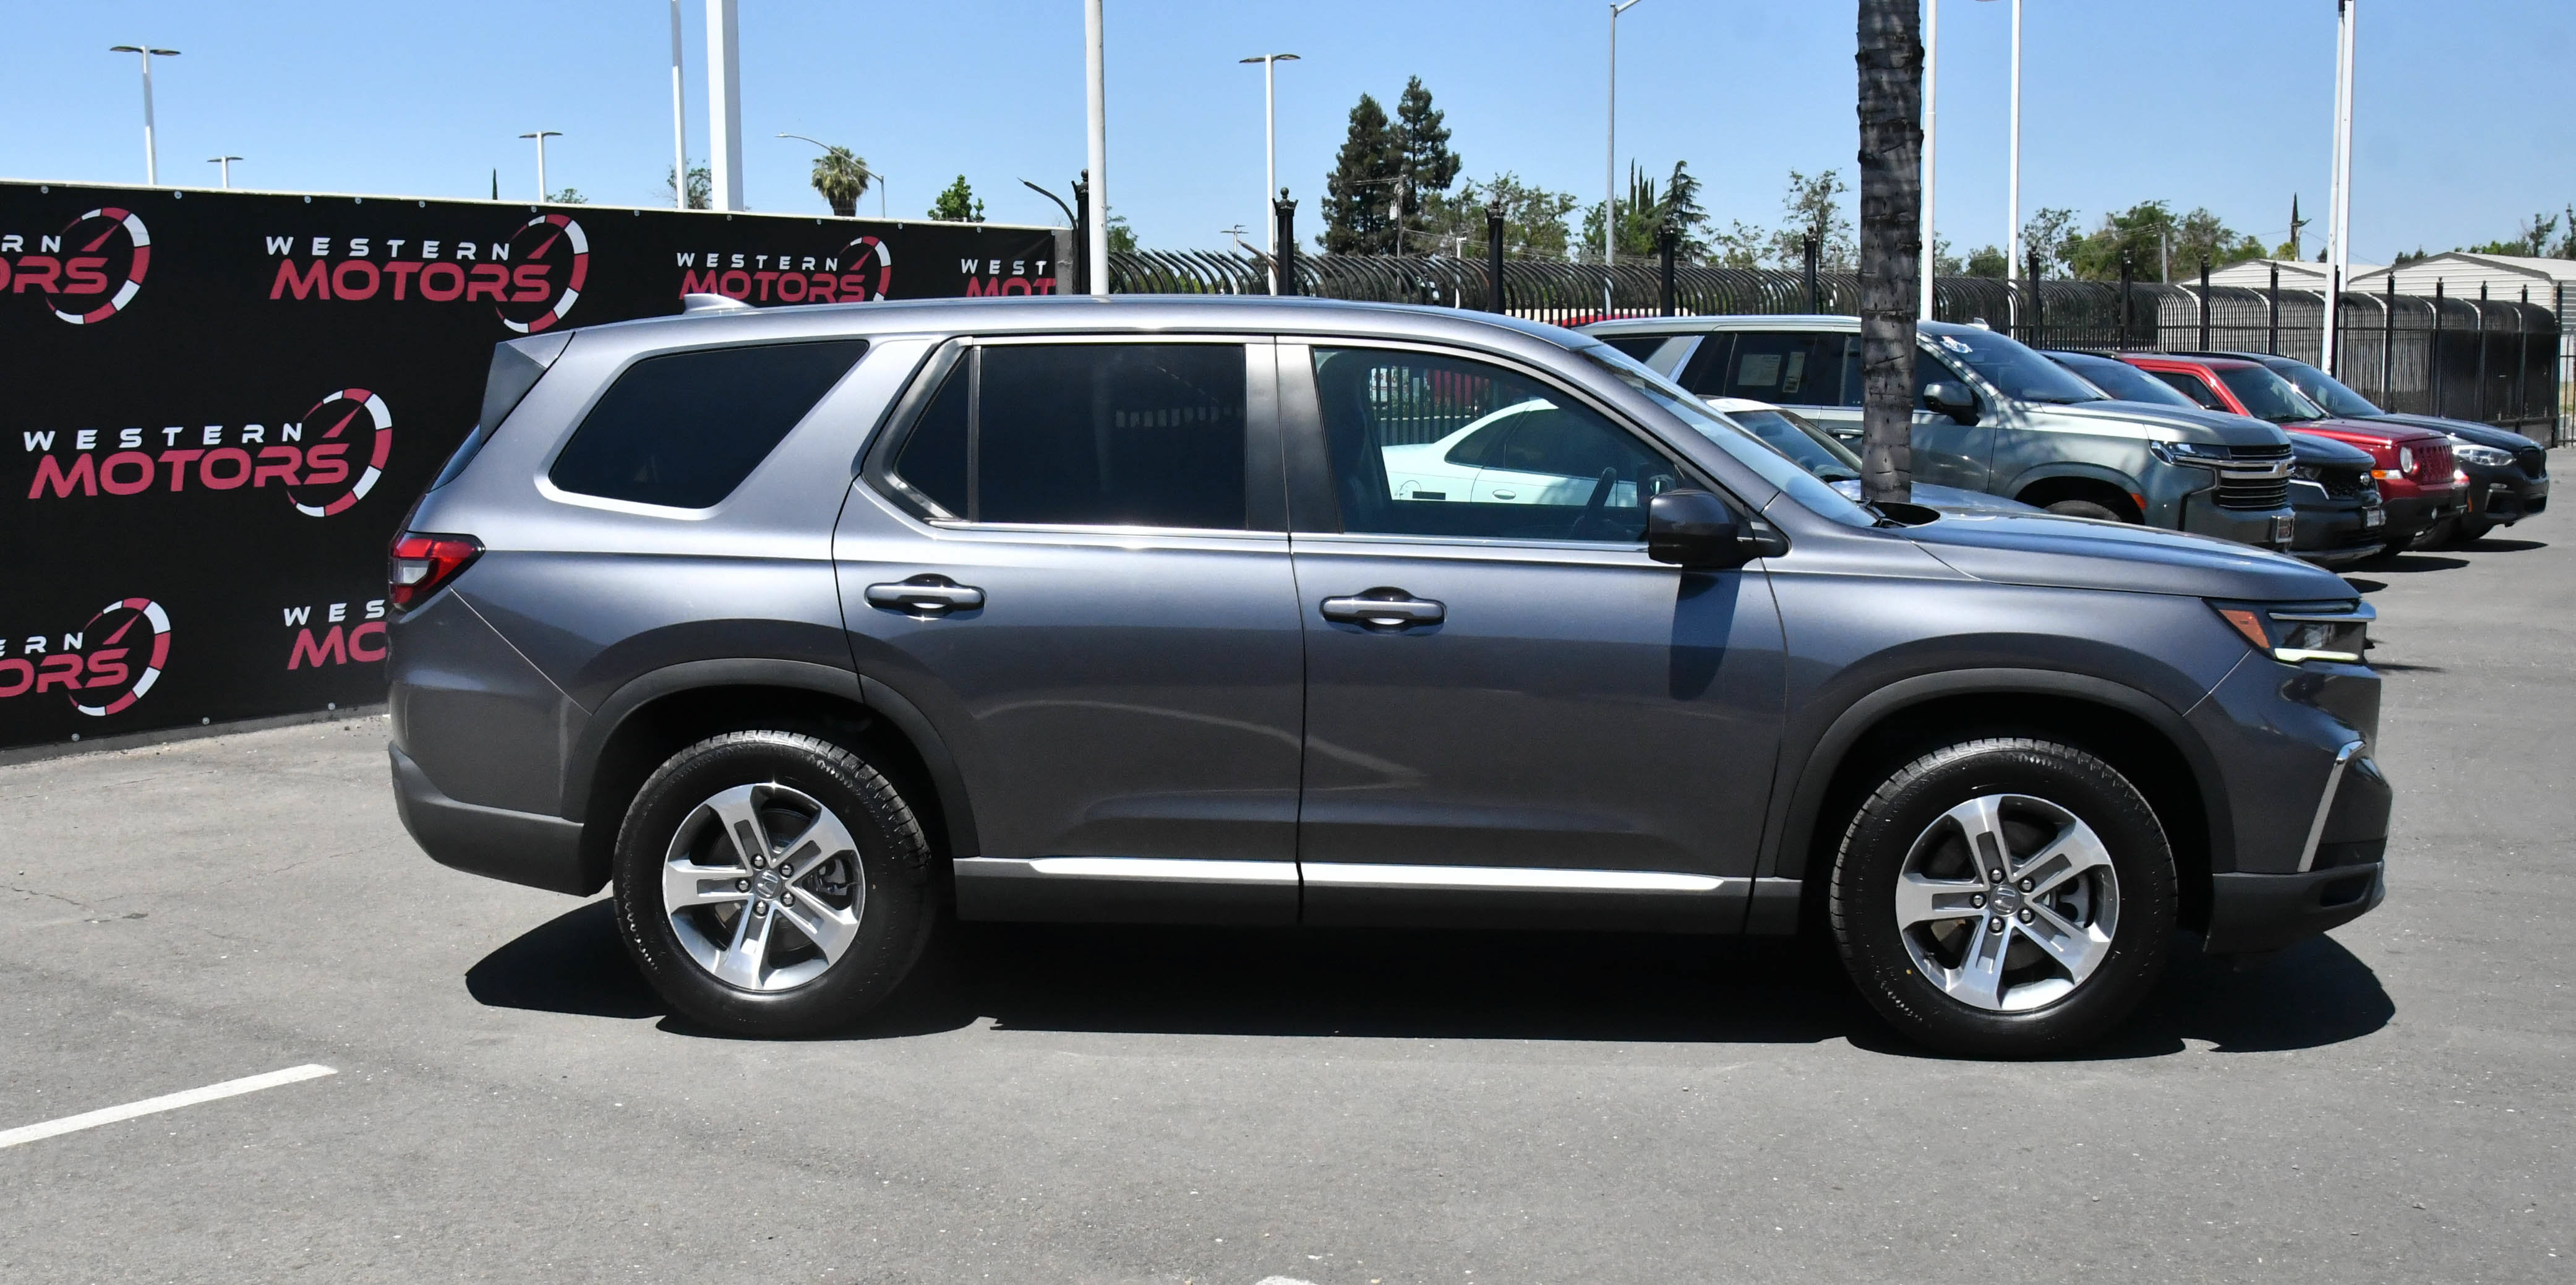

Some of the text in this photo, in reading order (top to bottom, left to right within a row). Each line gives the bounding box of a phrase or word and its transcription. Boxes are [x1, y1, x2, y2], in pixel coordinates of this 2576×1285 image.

[266, 236, 510, 260] WESTERN
[677, 252, 838, 272] WESTERN
[270, 259, 551, 303] MOTORS
[961, 259, 1047, 275] WEST
[679, 269, 865, 303] MOTORS
[24, 423, 302, 452] WESTERN
[28, 443, 349, 499] MOTORS
[283, 600, 385, 627] WES
